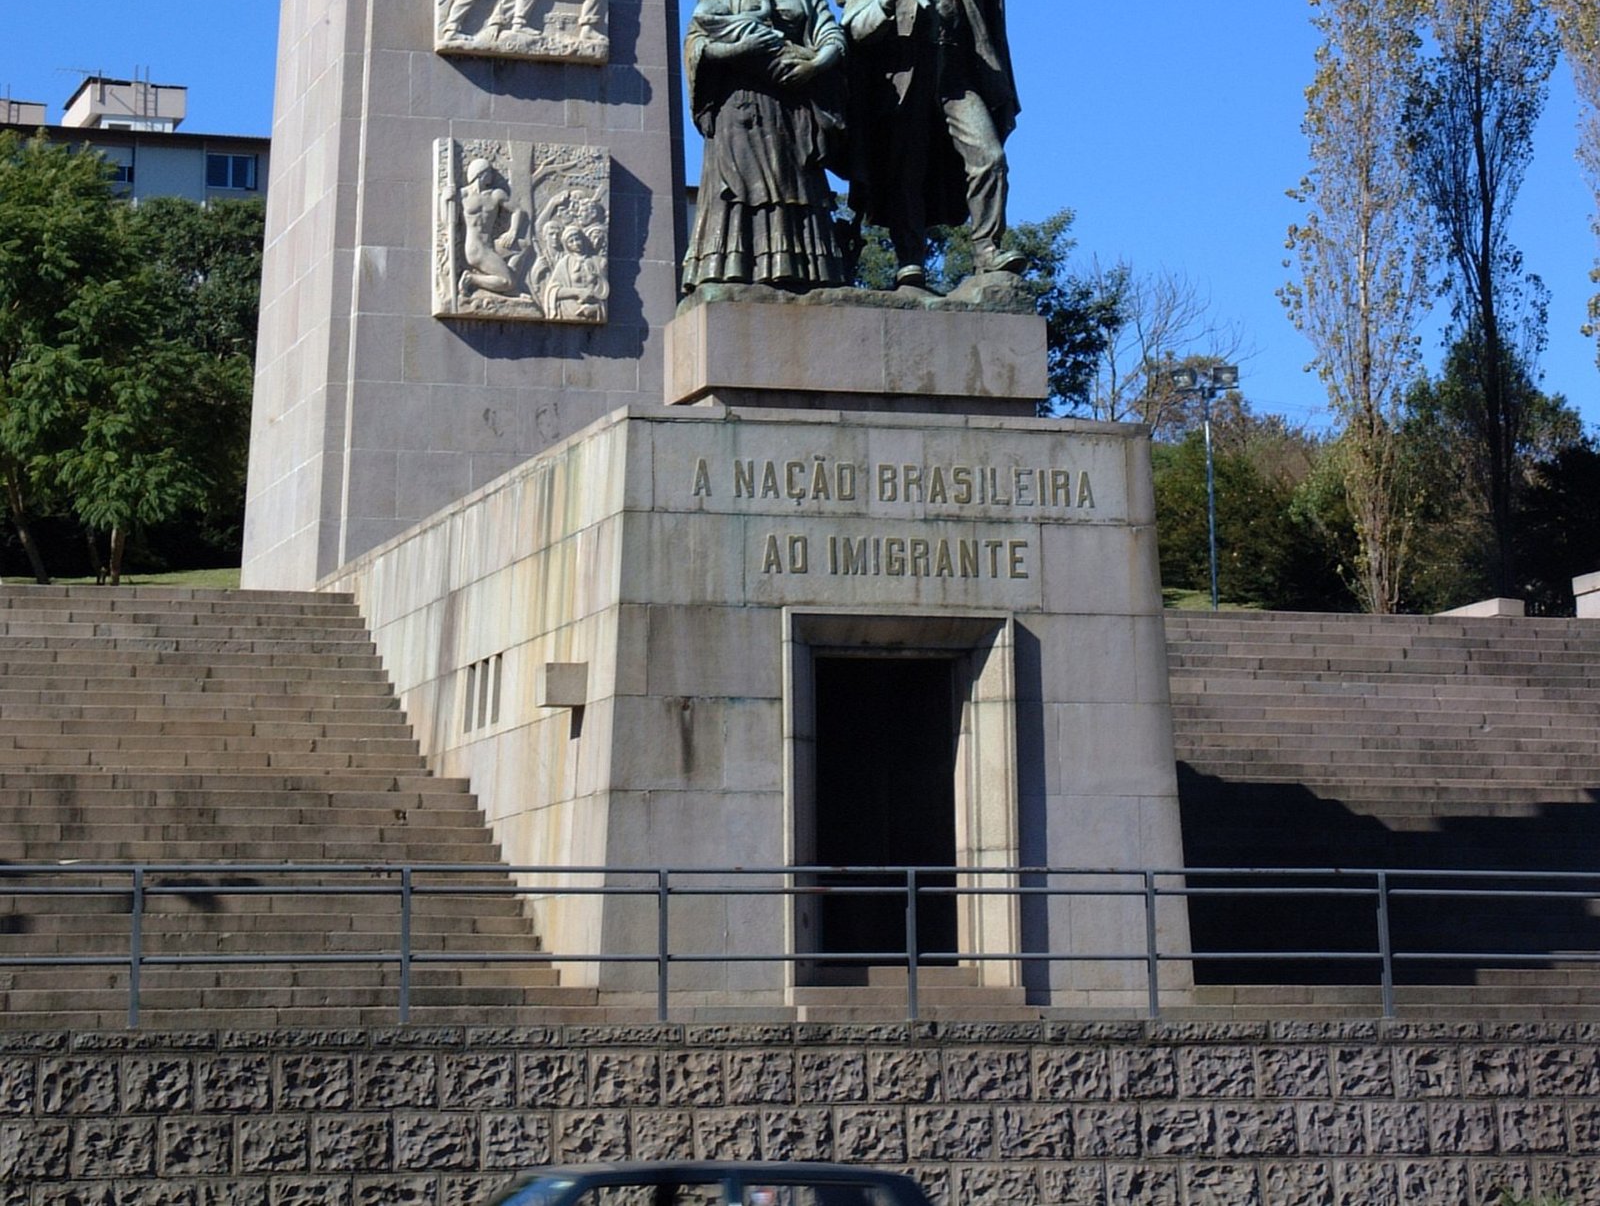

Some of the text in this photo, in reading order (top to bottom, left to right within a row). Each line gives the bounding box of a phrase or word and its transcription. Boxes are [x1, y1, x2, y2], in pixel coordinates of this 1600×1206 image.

[692, 454, 1096, 509] A NAÇÃO BRASILEIRA
[761, 533, 1029, 579] AO IMIGRANTE
